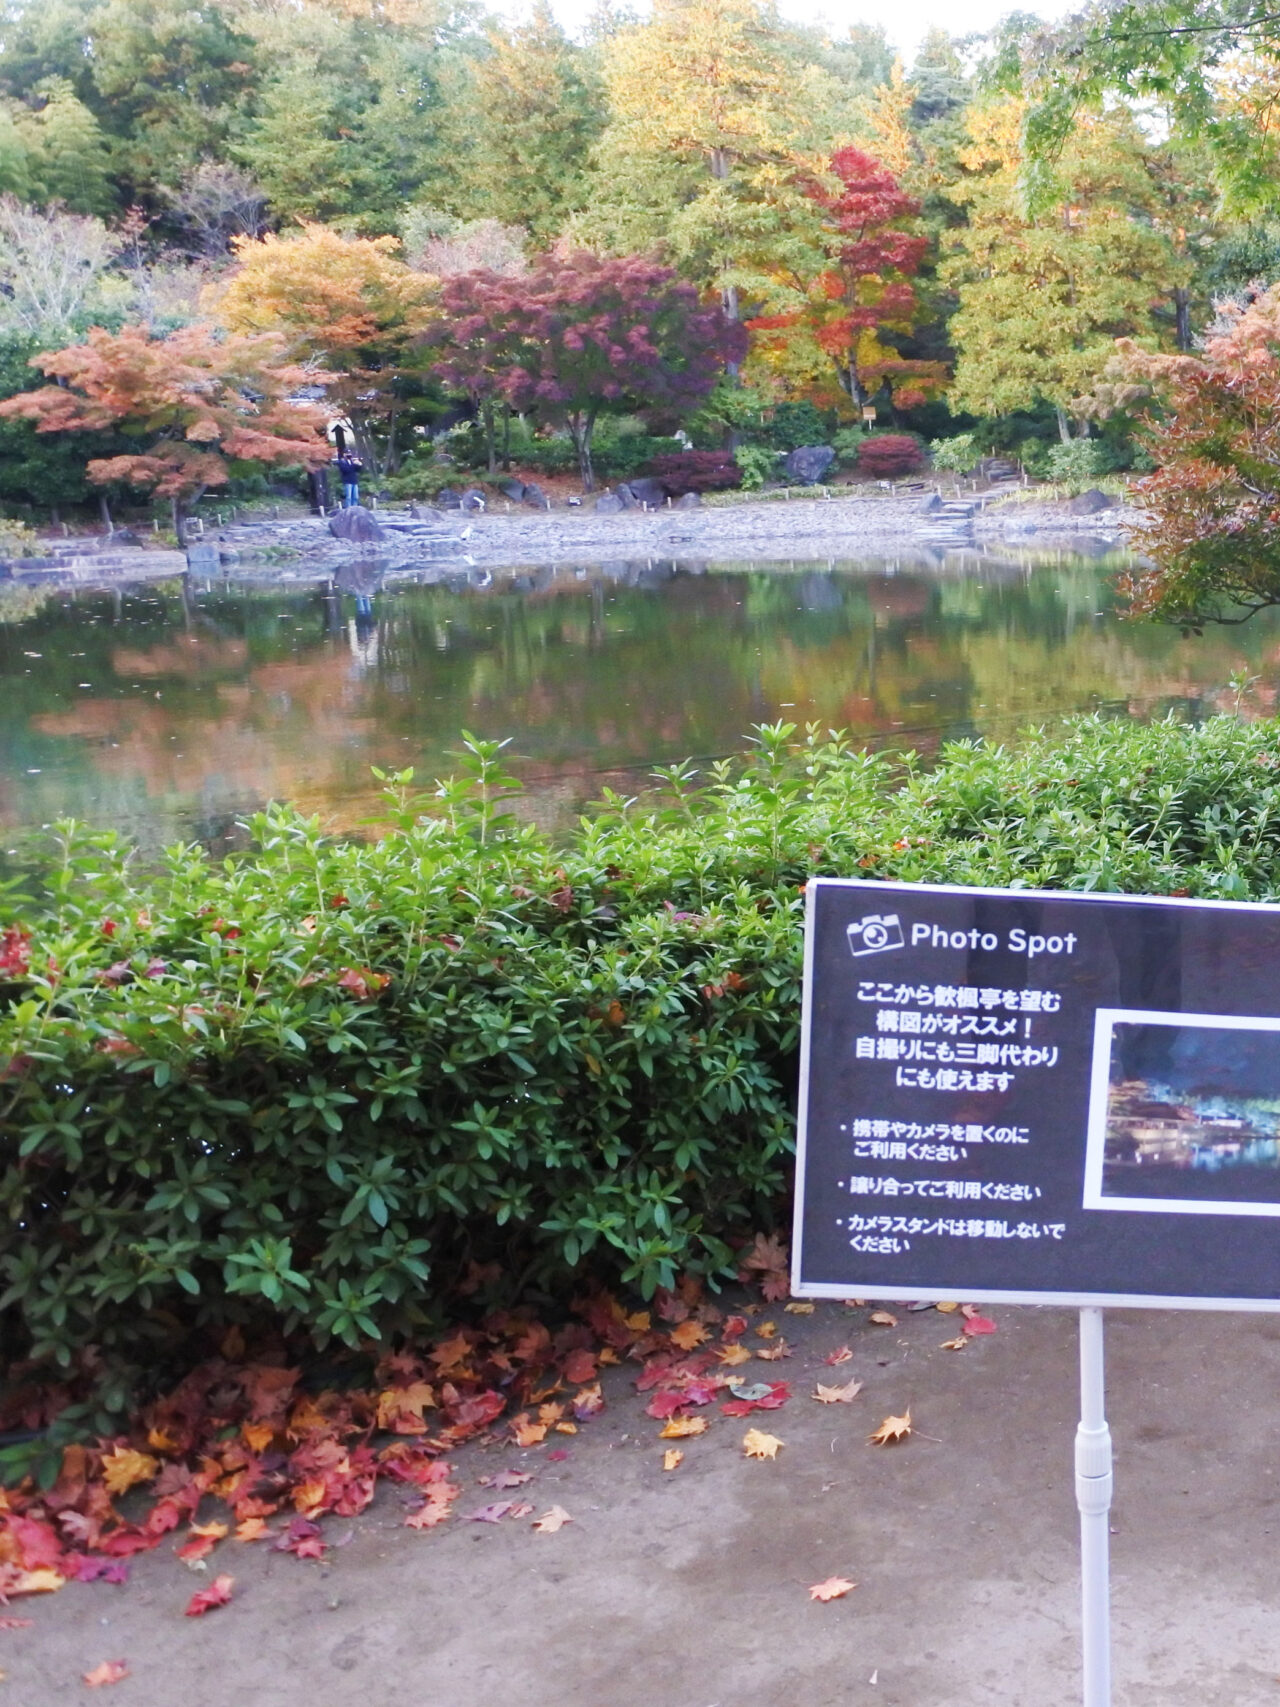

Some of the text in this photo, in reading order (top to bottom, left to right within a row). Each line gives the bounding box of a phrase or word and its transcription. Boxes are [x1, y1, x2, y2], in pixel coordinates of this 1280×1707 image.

[911, 923, 1078, 958] Photo Spot
[855, 1036, 1059, 1068] 自撮りにも三脚代わり
[895, 1066, 1015, 1092] にも使えます
[853, 1140, 968, 1162] ご利用ください
[849, 1235, 911, 1254] ください
